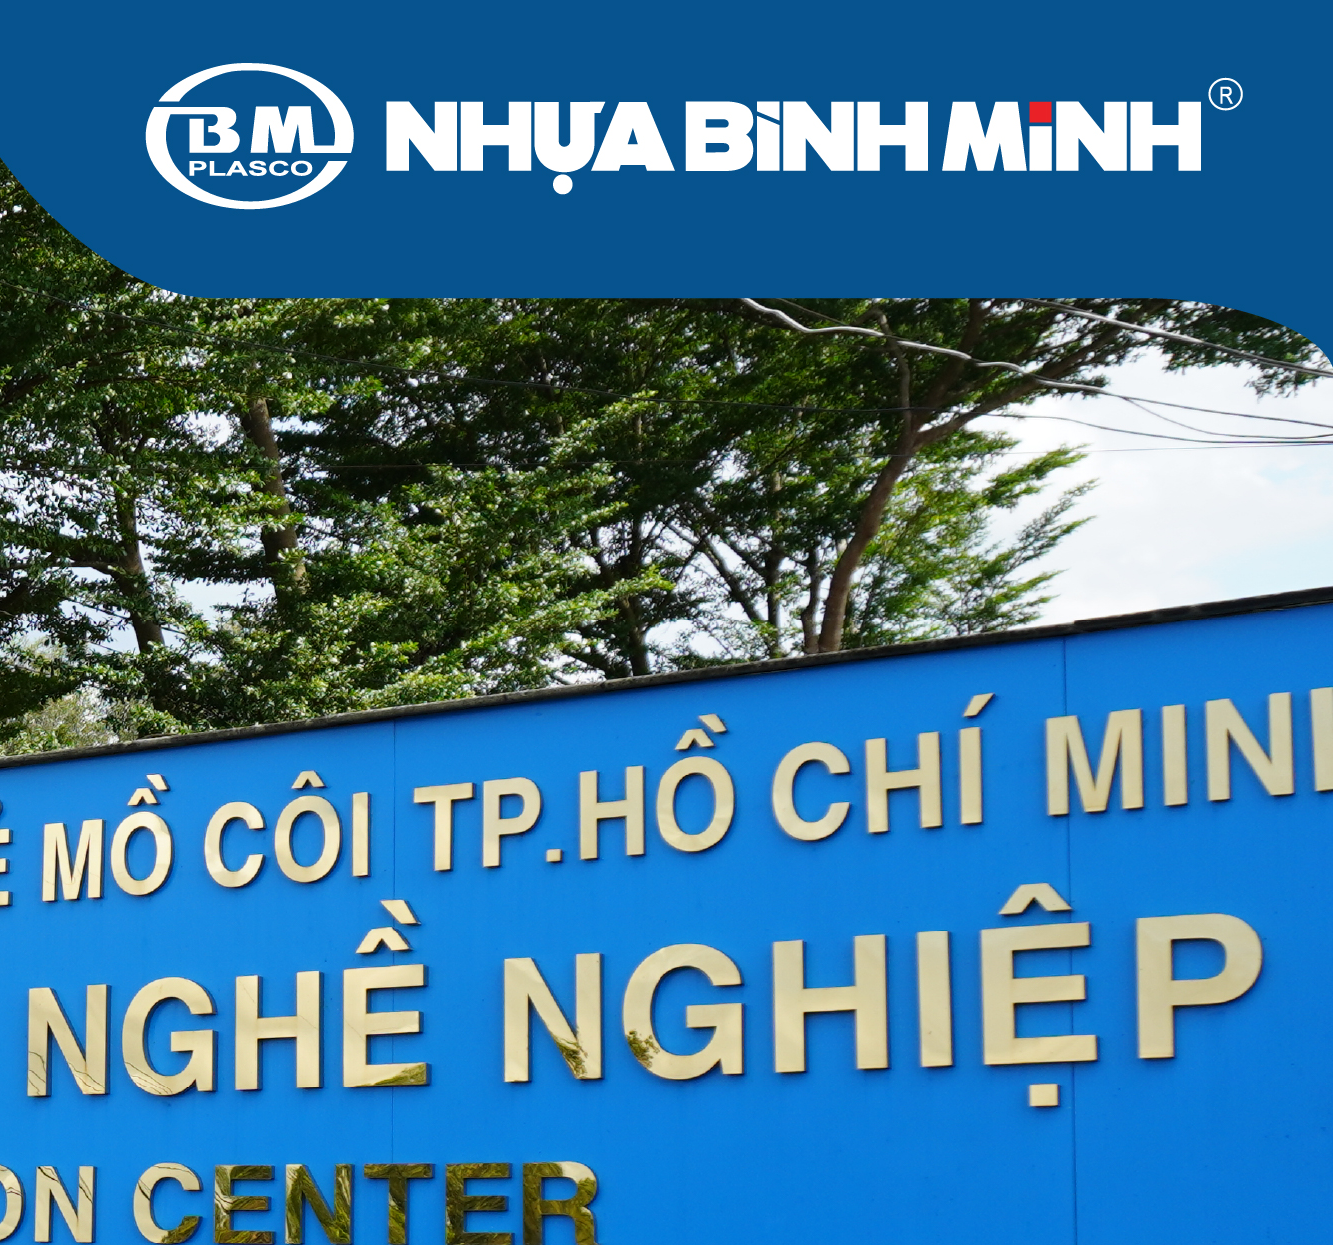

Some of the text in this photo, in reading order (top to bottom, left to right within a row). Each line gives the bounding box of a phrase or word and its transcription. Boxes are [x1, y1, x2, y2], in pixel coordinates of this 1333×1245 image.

[42, 774, 174, 902] MỒ
[204, 770, 371, 888] CÔI
[771, 693, 996, 842] CHÍ
[1045, 687, 1333, 816] MIN
[27, 899, 430, 1097] NGHỀ
[503, 883, 1264, 1108] NGHIỆP
